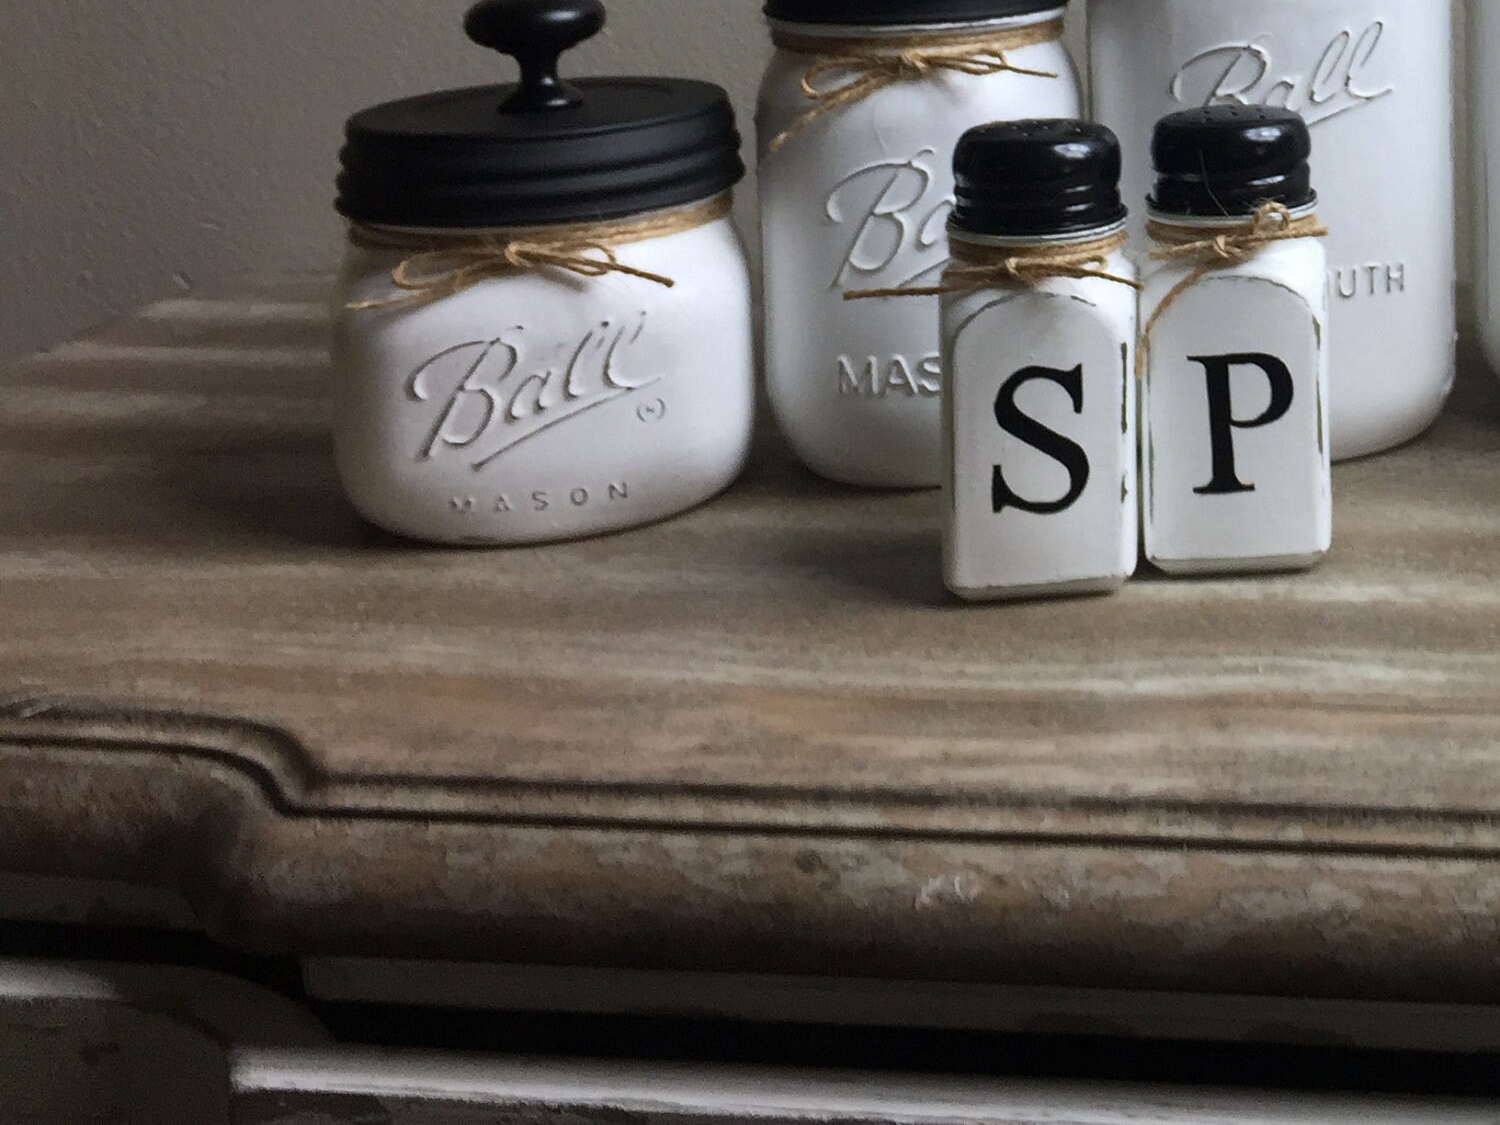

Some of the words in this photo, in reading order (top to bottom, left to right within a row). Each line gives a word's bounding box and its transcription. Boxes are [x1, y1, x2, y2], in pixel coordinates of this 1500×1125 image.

[1169, 20, 1395, 125] Ball
[826, 145, 957, 291] Ba
[1336, 262, 1405, 298] UTH
[405, 311, 661, 472] Ball
[836, 351, 940, 397] MAS
[1186, 351, 1296, 496] P
[448, 480, 629, 515] MASON
[991, 363, 1091, 516] S
